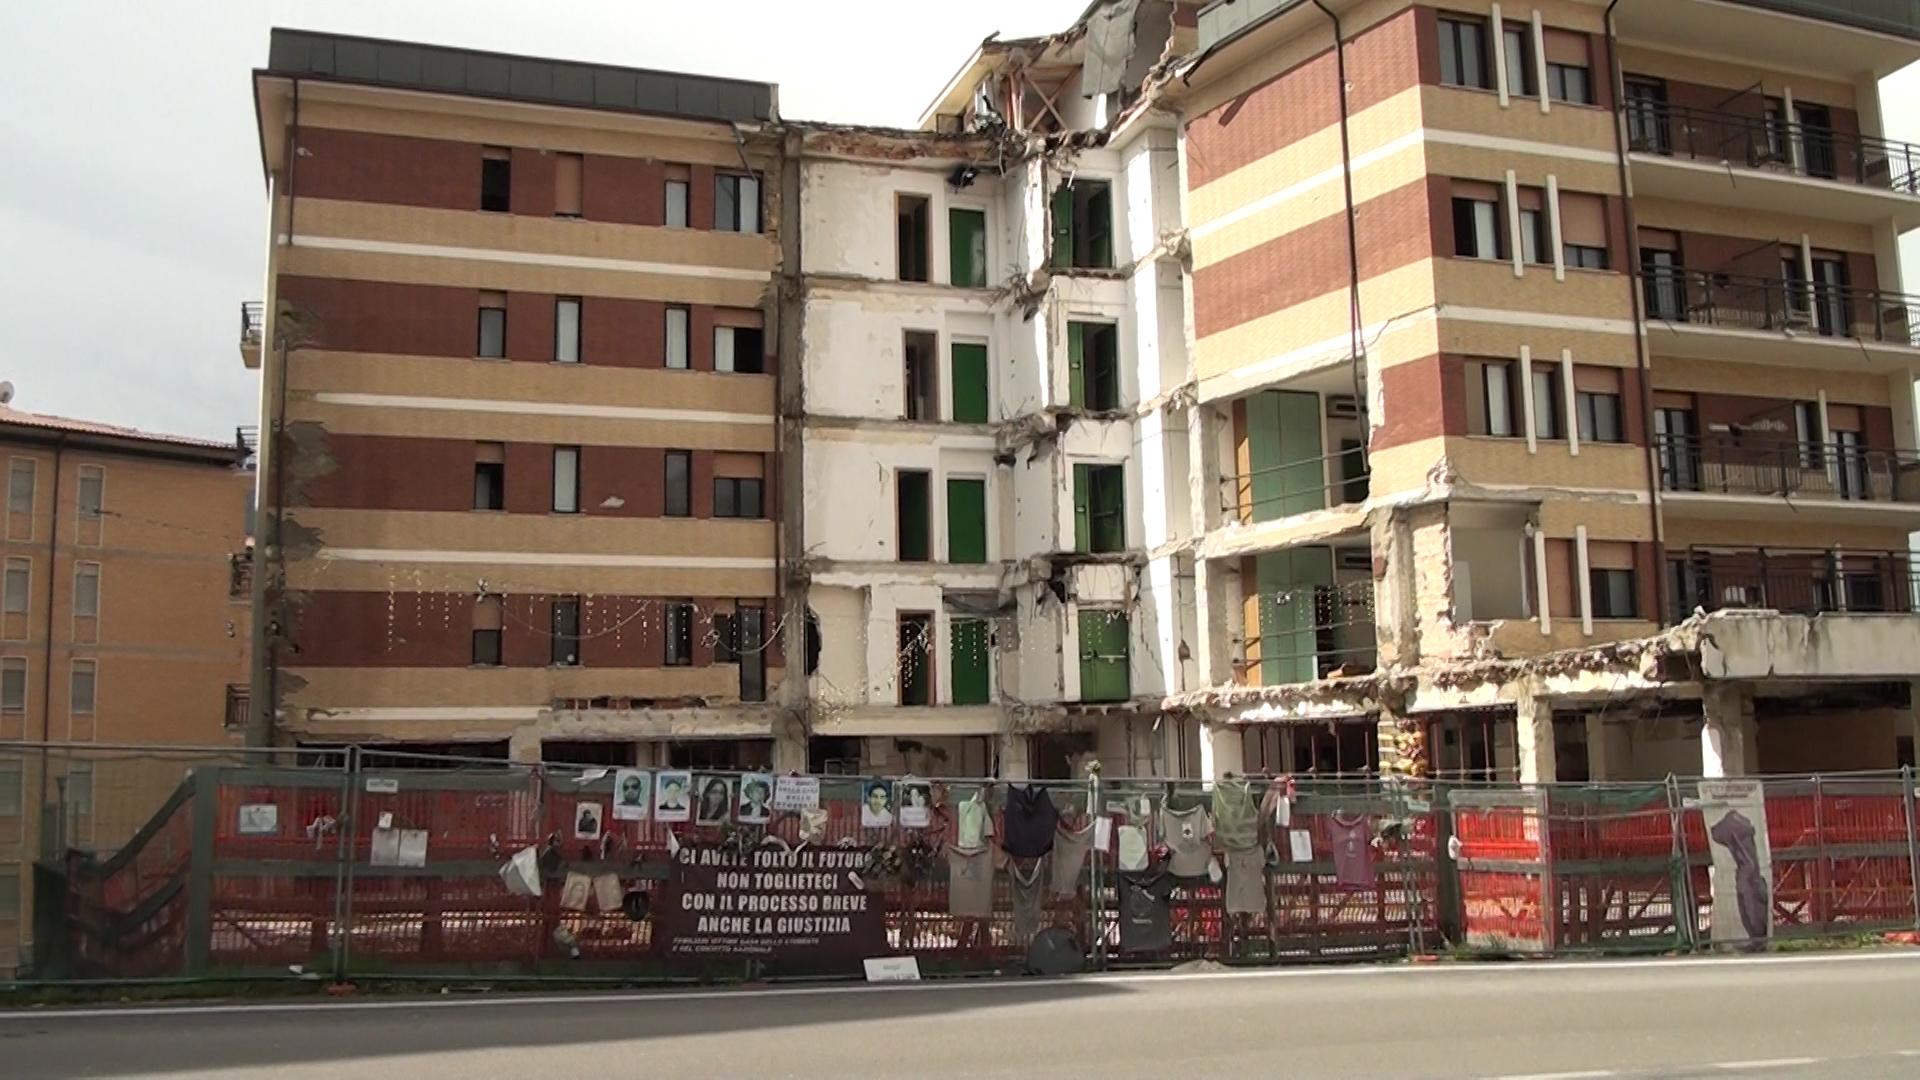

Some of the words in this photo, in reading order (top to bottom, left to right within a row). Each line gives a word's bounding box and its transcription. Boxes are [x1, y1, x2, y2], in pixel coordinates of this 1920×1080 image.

[679, 848, 696, 864] CI
[753, 851, 798, 868] TOLTO
[802, 851, 815, 868] IL
[716, 872, 750, 888] NON
[755, 872, 838, 890] TOGLIETECI
[681, 893, 715, 910] CON
[719, 894, 734, 910] IL
[738, 895, 818, 912] PROCESSO
[822, 895, 867, 911] BREVE
[697, 917, 751, 934] ANCHE
[755, 917, 773, 934] LA
[777, 917, 851, 934] GIUSTIZIA
